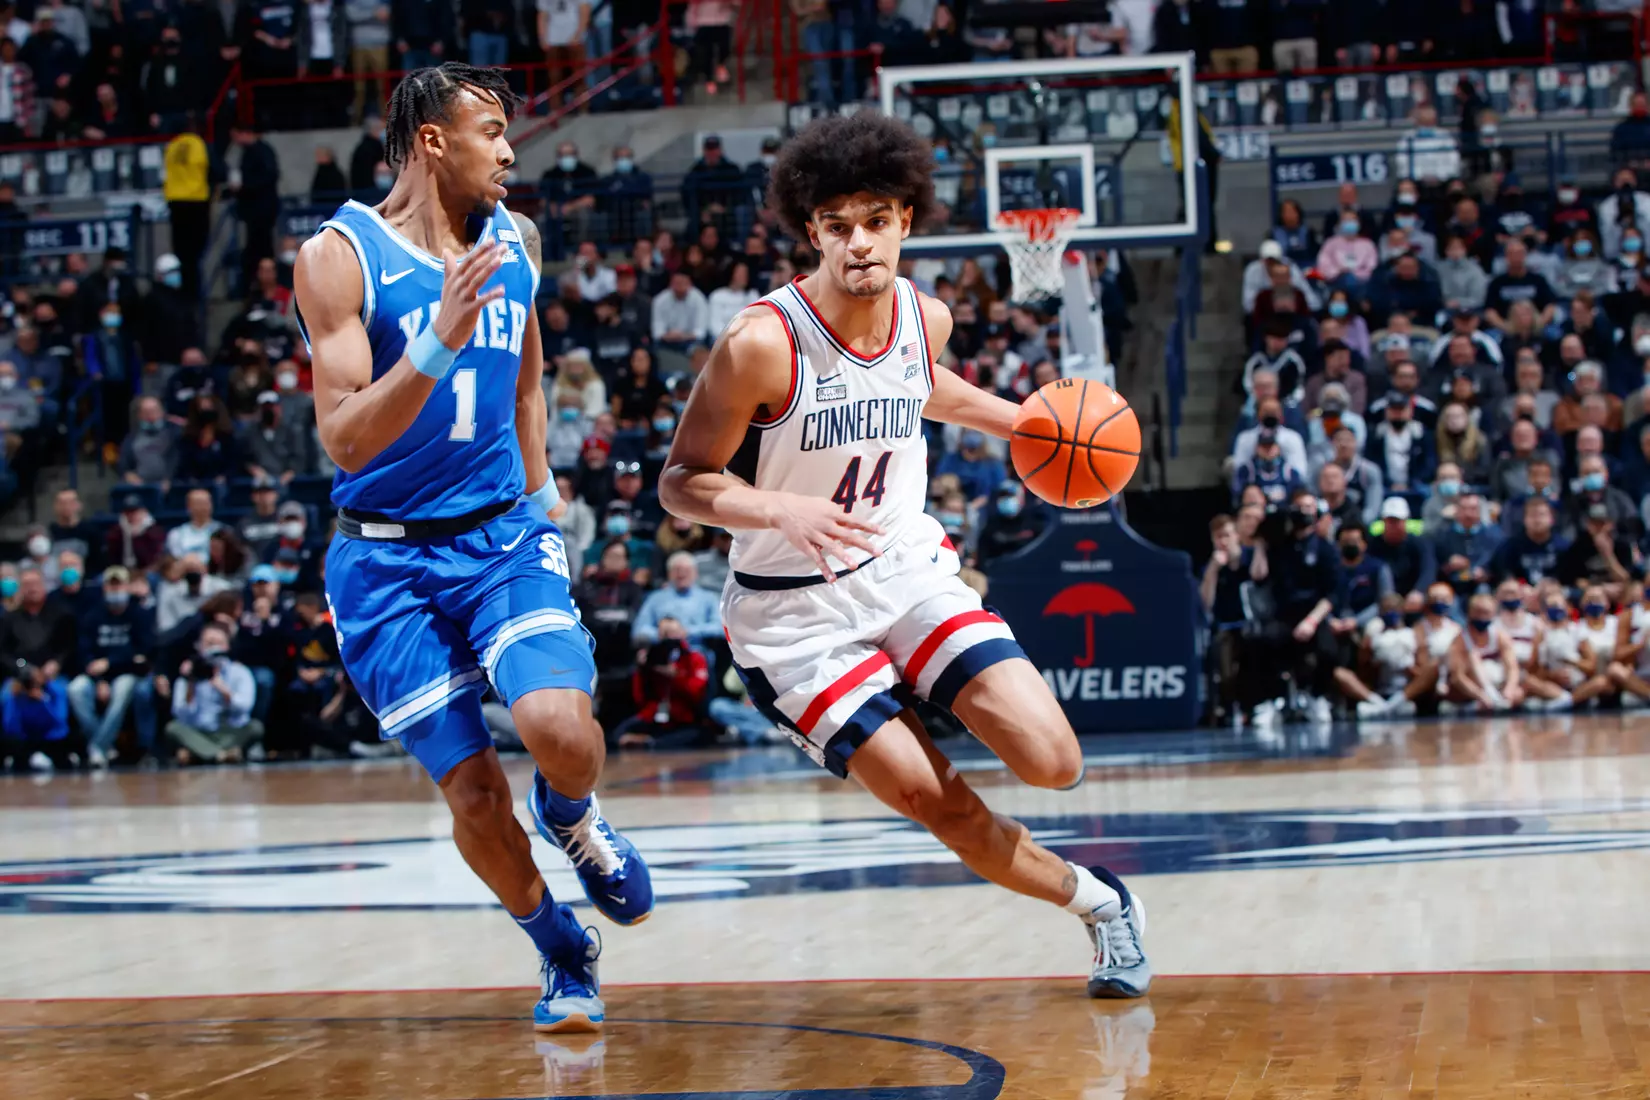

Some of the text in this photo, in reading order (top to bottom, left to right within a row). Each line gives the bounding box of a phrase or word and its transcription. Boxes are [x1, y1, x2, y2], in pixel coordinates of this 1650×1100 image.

[1276, 153, 1388, 184] SEC 116
[398, 298, 527, 357] XIER
[448, 368, 477, 442] 1
[830, 451, 893, 513] 44
[1042, 665, 1187, 701] AVELERS
